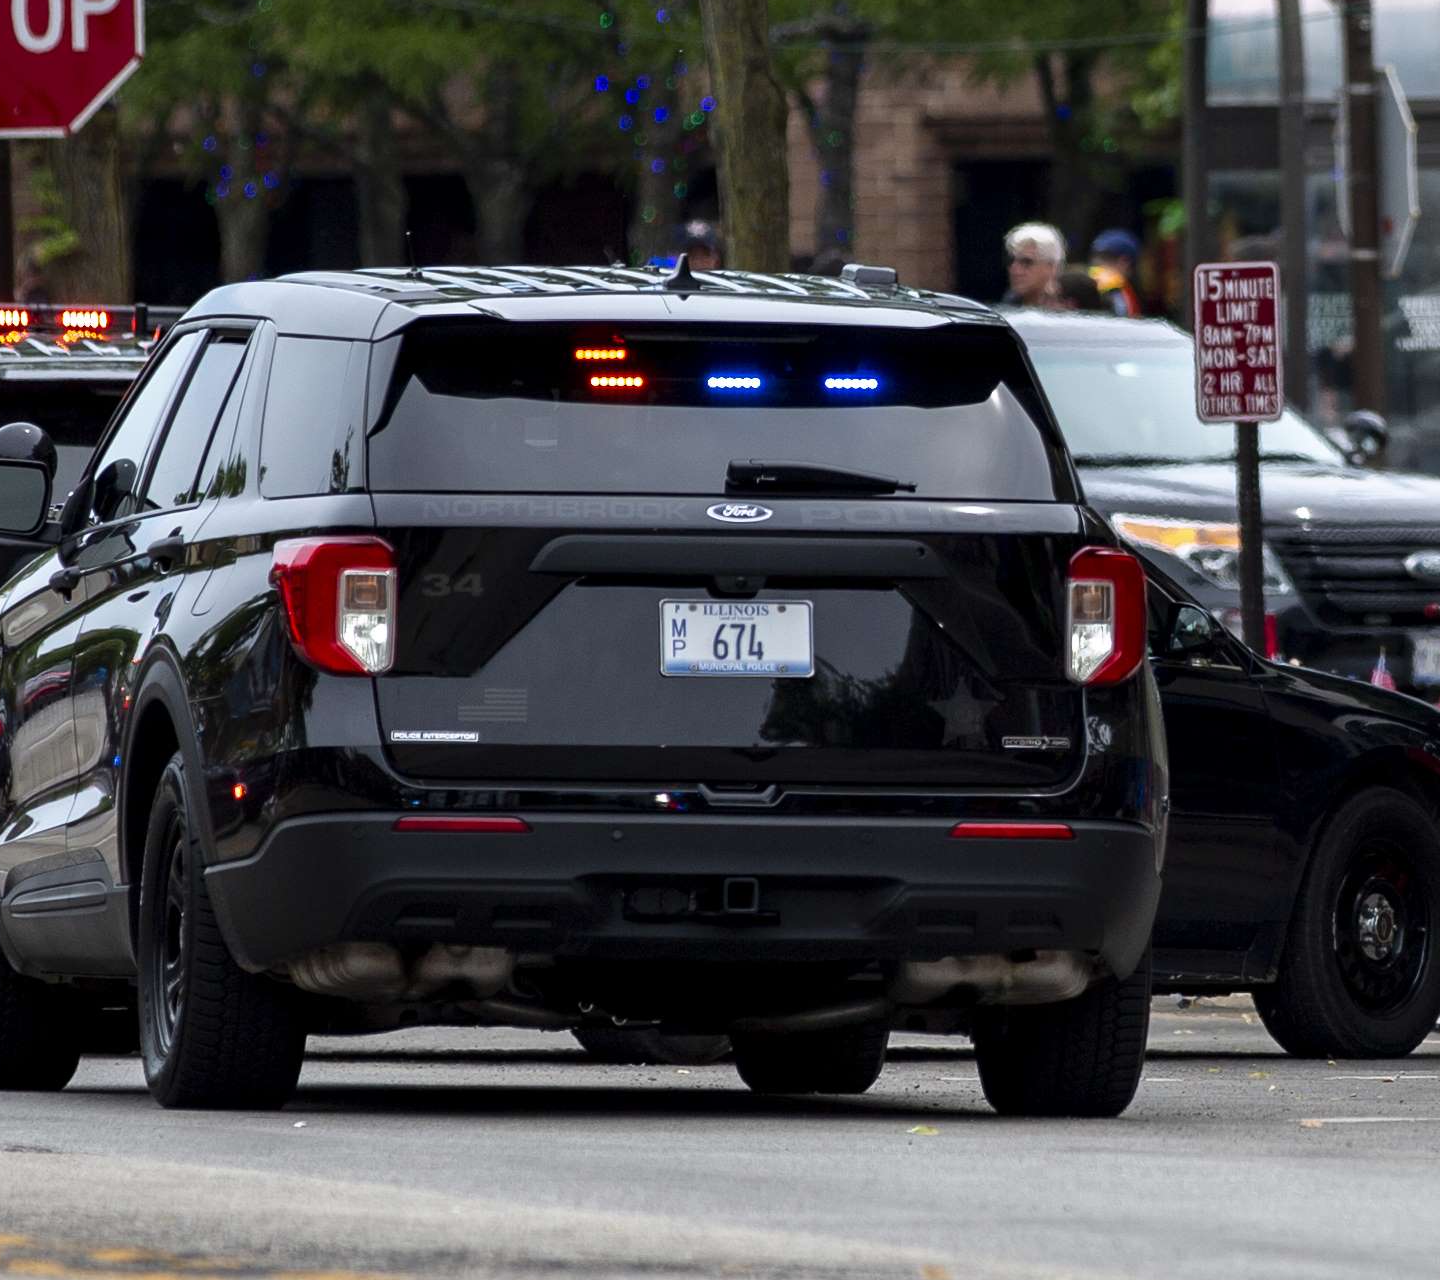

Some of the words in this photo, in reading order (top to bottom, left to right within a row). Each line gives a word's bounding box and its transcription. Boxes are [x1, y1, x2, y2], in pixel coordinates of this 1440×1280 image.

[1198, 271, 1224, 301] 15
[1224, 277, 1274, 300] MINUTE
[1216, 301, 1259, 323] LIMIT
[1200, 345, 1276, 368] MON-SAT
[1204, 372, 1216, 394] 2
[1220, 371, 1242, 393] HR
[1253, 372, 1276, 393] ALL
[1201, 395, 1241, 414] OTHER
[1244, 393, 1279, 414] TIMES
[421, 499, 690, 521] NORTHBROOK
[421, 572, 484, 598] 34
[703, 604, 769, 617] ILLINOIS
[713, 623, 764, 661] 674
[698, 662, 745, 671] MUNICIPAL
[746, 662, 775, 671] POLICE
